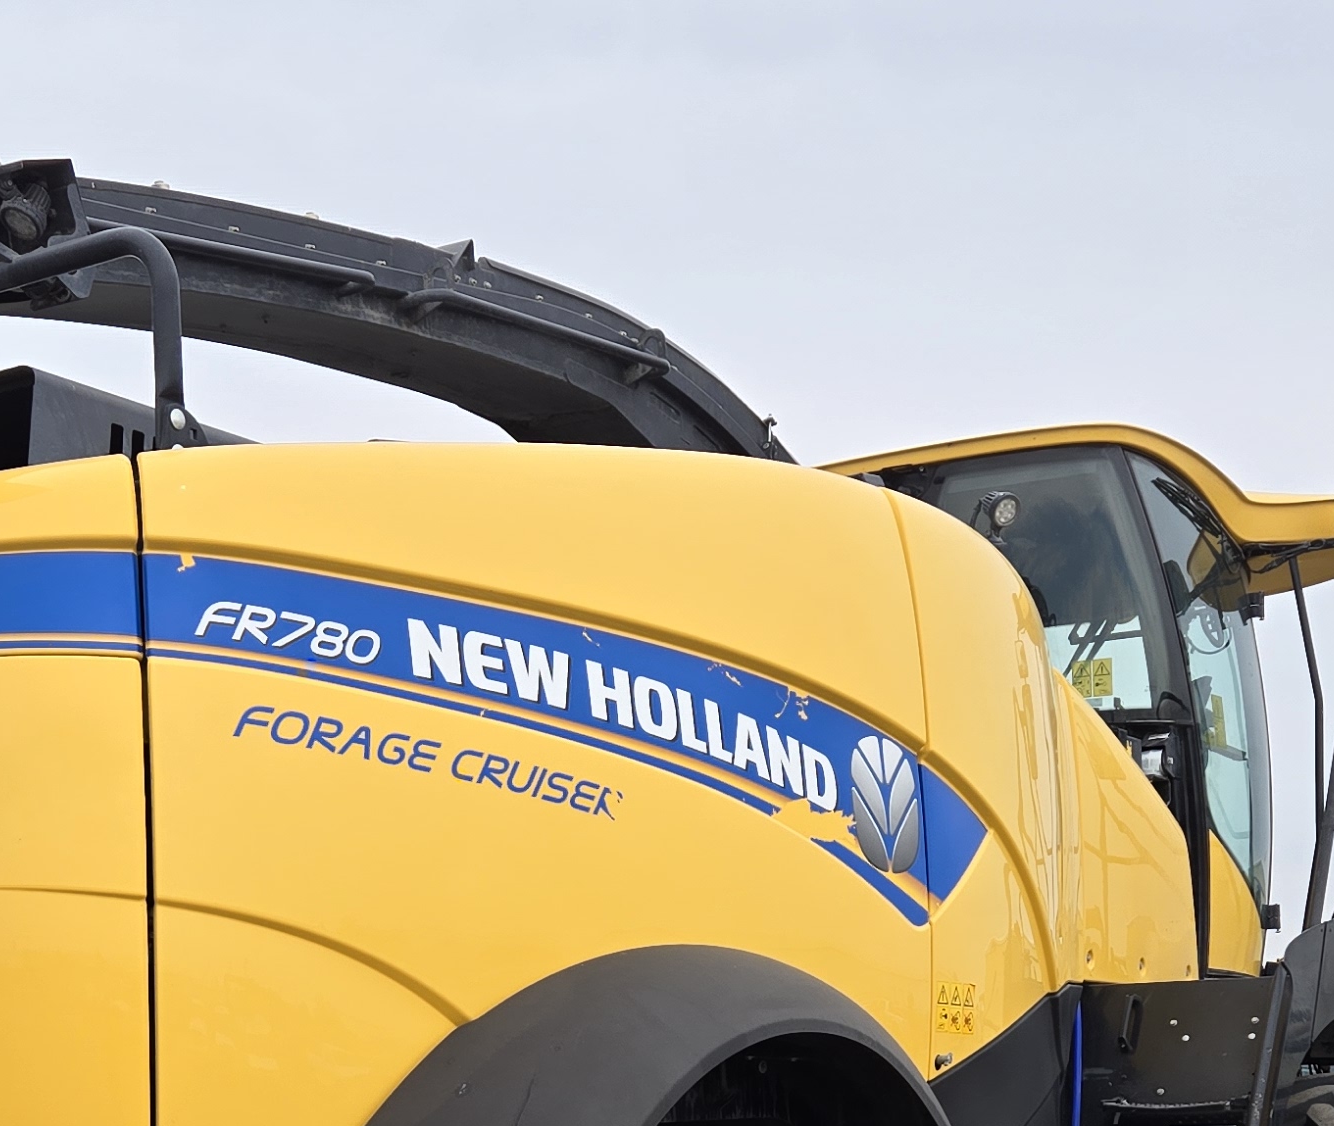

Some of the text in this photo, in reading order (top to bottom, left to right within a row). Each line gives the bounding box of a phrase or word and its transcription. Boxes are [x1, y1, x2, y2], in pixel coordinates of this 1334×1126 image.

[194, 601, 381, 665] FR780
[233, 705, 442, 773] FORAGE
[407, 617, 839, 813] NEW HOLLAND
